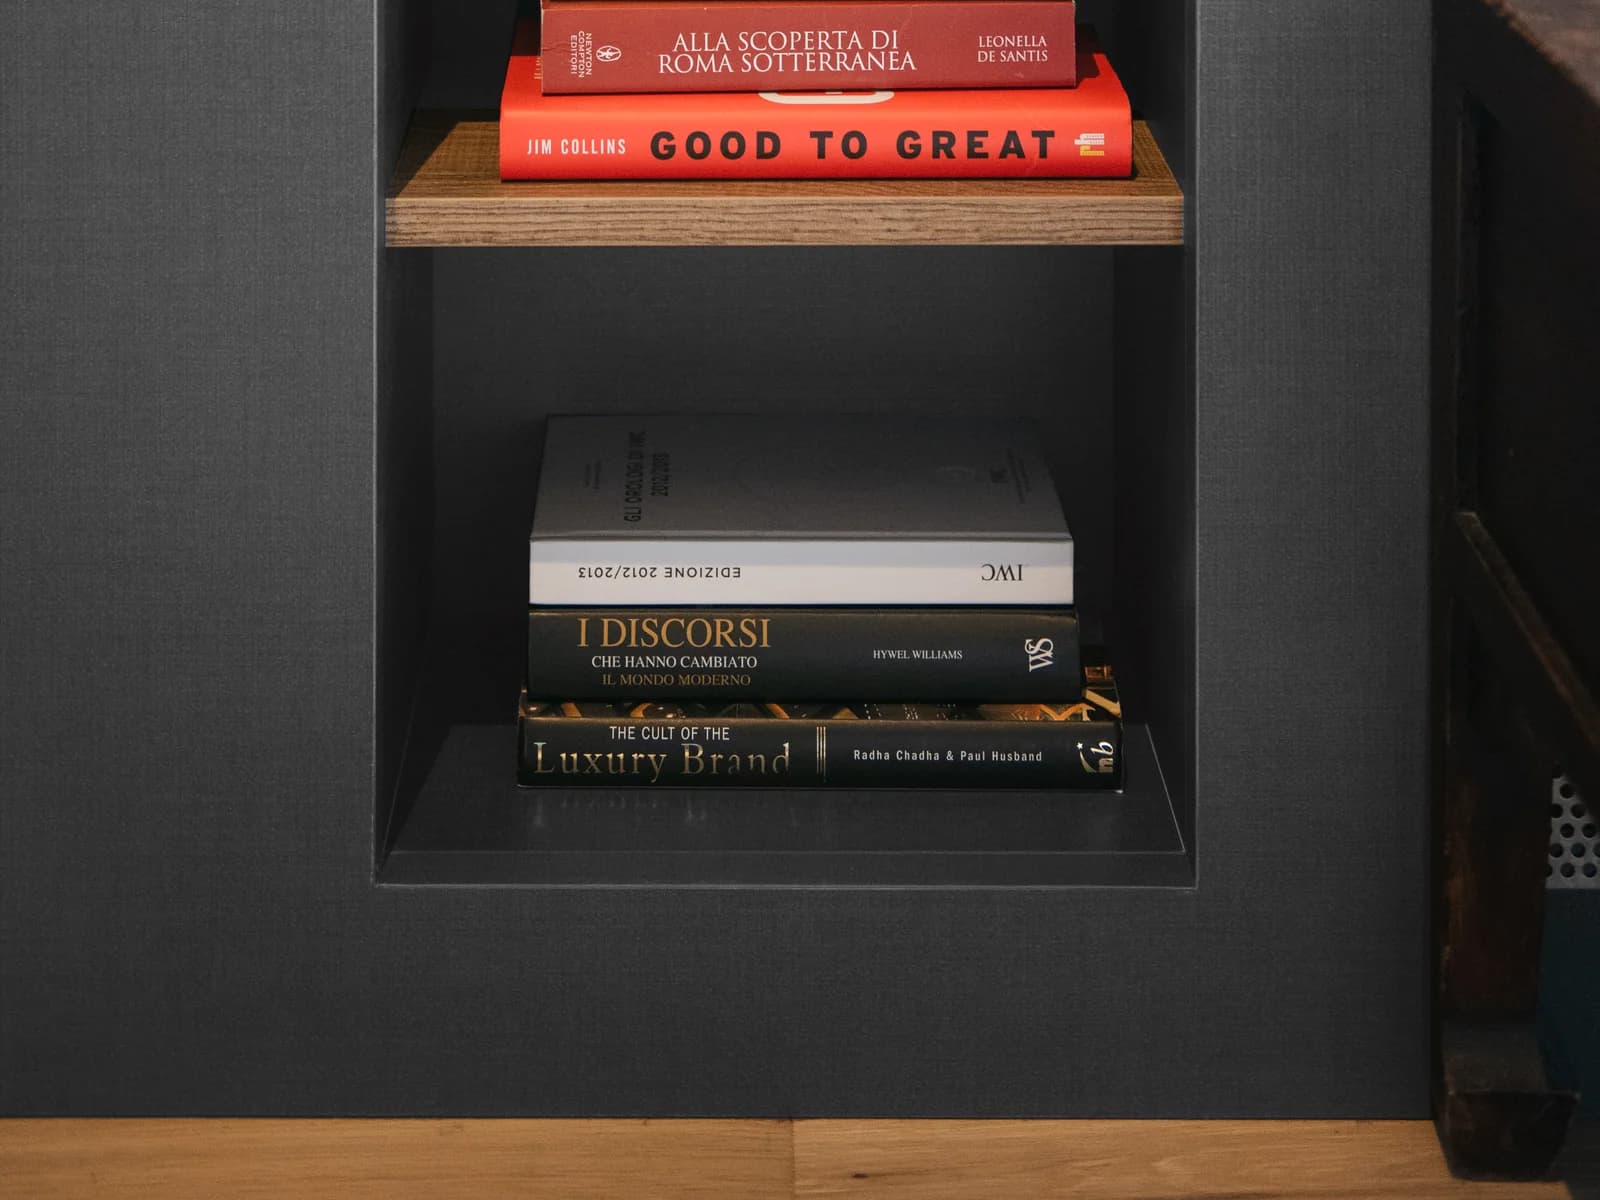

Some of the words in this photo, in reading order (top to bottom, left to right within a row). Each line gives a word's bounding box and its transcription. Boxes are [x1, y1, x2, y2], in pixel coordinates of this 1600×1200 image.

[672, 32, 730, 52] ALLA
[738, 30, 865, 51] SCOPERTA
[872, 30, 899, 50] DI
[978, 35, 1047, 48] LEONELLA
[658, 54, 734, 74] ROMA
[741, 51, 917, 74] SOTTERRANEA
[977, 50, 995, 62] DE
[1000, 50, 1048, 62] SANTIS
[527, 139, 552, 154] JIM
[560, 138, 626, 154] COLLINS
[650, 131, 781, 160] GOOD
[809, 130, 868, 160] TO
[896, 130, 1055, 160] GREAT
[623, 506, 642, 522] GLI
[578, 566, 657, 579] 2012/2013
[664, 566, 741, 578] EDIZIONE
[981, 564, 1023, 582] IWC
[577, 618, 590, 648] I
[600, 618, 771, 648] DISCORSI
[591, 656, 622, 668] CHE
[624, 656, 677, 668] HANNO
[680, 656, 758, 668] CAMBIATO
[873, 650, 910, 660] HYWEL
[912, 650, 963, 660] WILLIAMS
[602, 674, 616, 686] IL
[620, 674, 675, 686] MONDO
[678, 674, 751, 686] MODERNO
[609, 726, 636, 740] THE
[641, 726, 675, 740] CULT
[681, 726, 698, 740] OF
[704, 726, 730, 741] THE
[533, 742, 668, 783] Luxury
[680, 742, 790, 775] Brand
[854, 750, 890, 761] Radha
[896, 750, 940, 762] Chadha
[946, 751, 954, 761] &
[960, 751, 986, 762] Paul
[992, 751, 1042, 762] Husband
